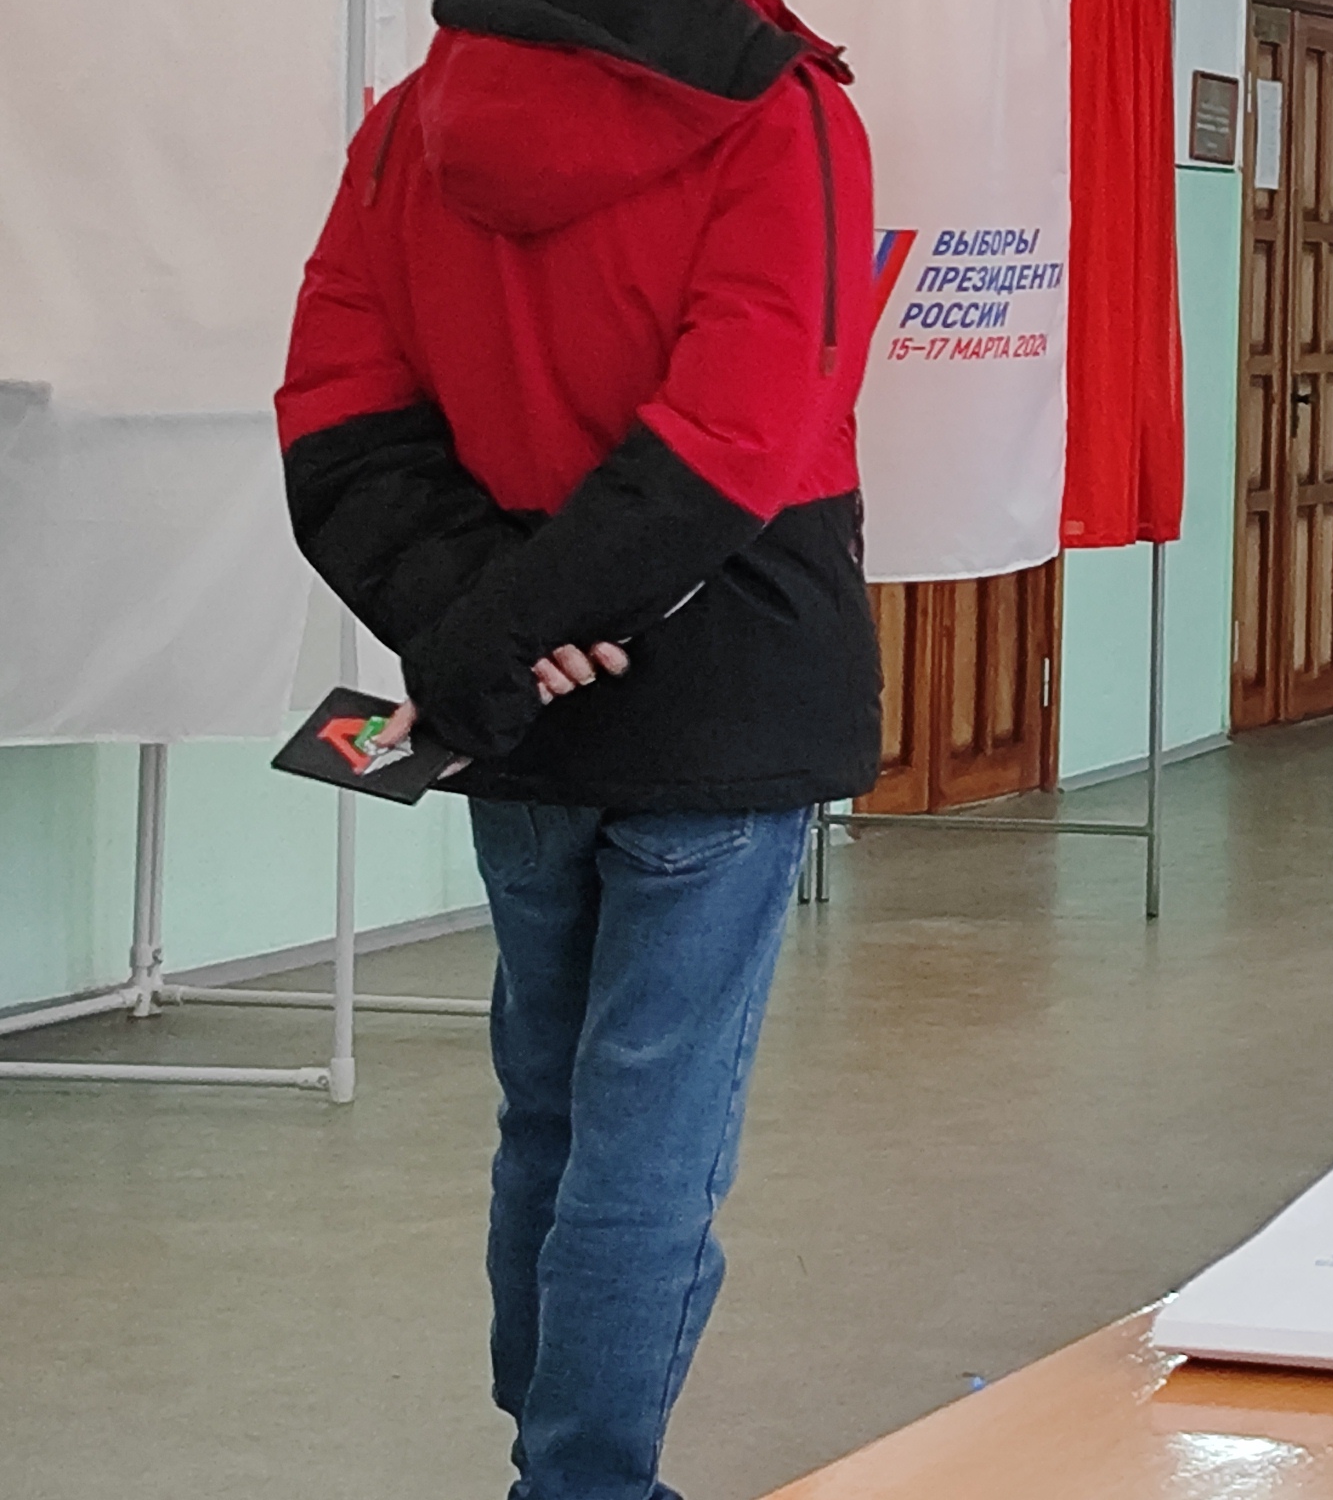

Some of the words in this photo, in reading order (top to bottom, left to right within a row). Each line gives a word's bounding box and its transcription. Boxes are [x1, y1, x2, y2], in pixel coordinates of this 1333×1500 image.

[932, 228, 1040, 256] ВЫБОРЫ
[899, 301, 1009, 329] РОССИИ
[949, 335, 1011, 360] МАРТА
